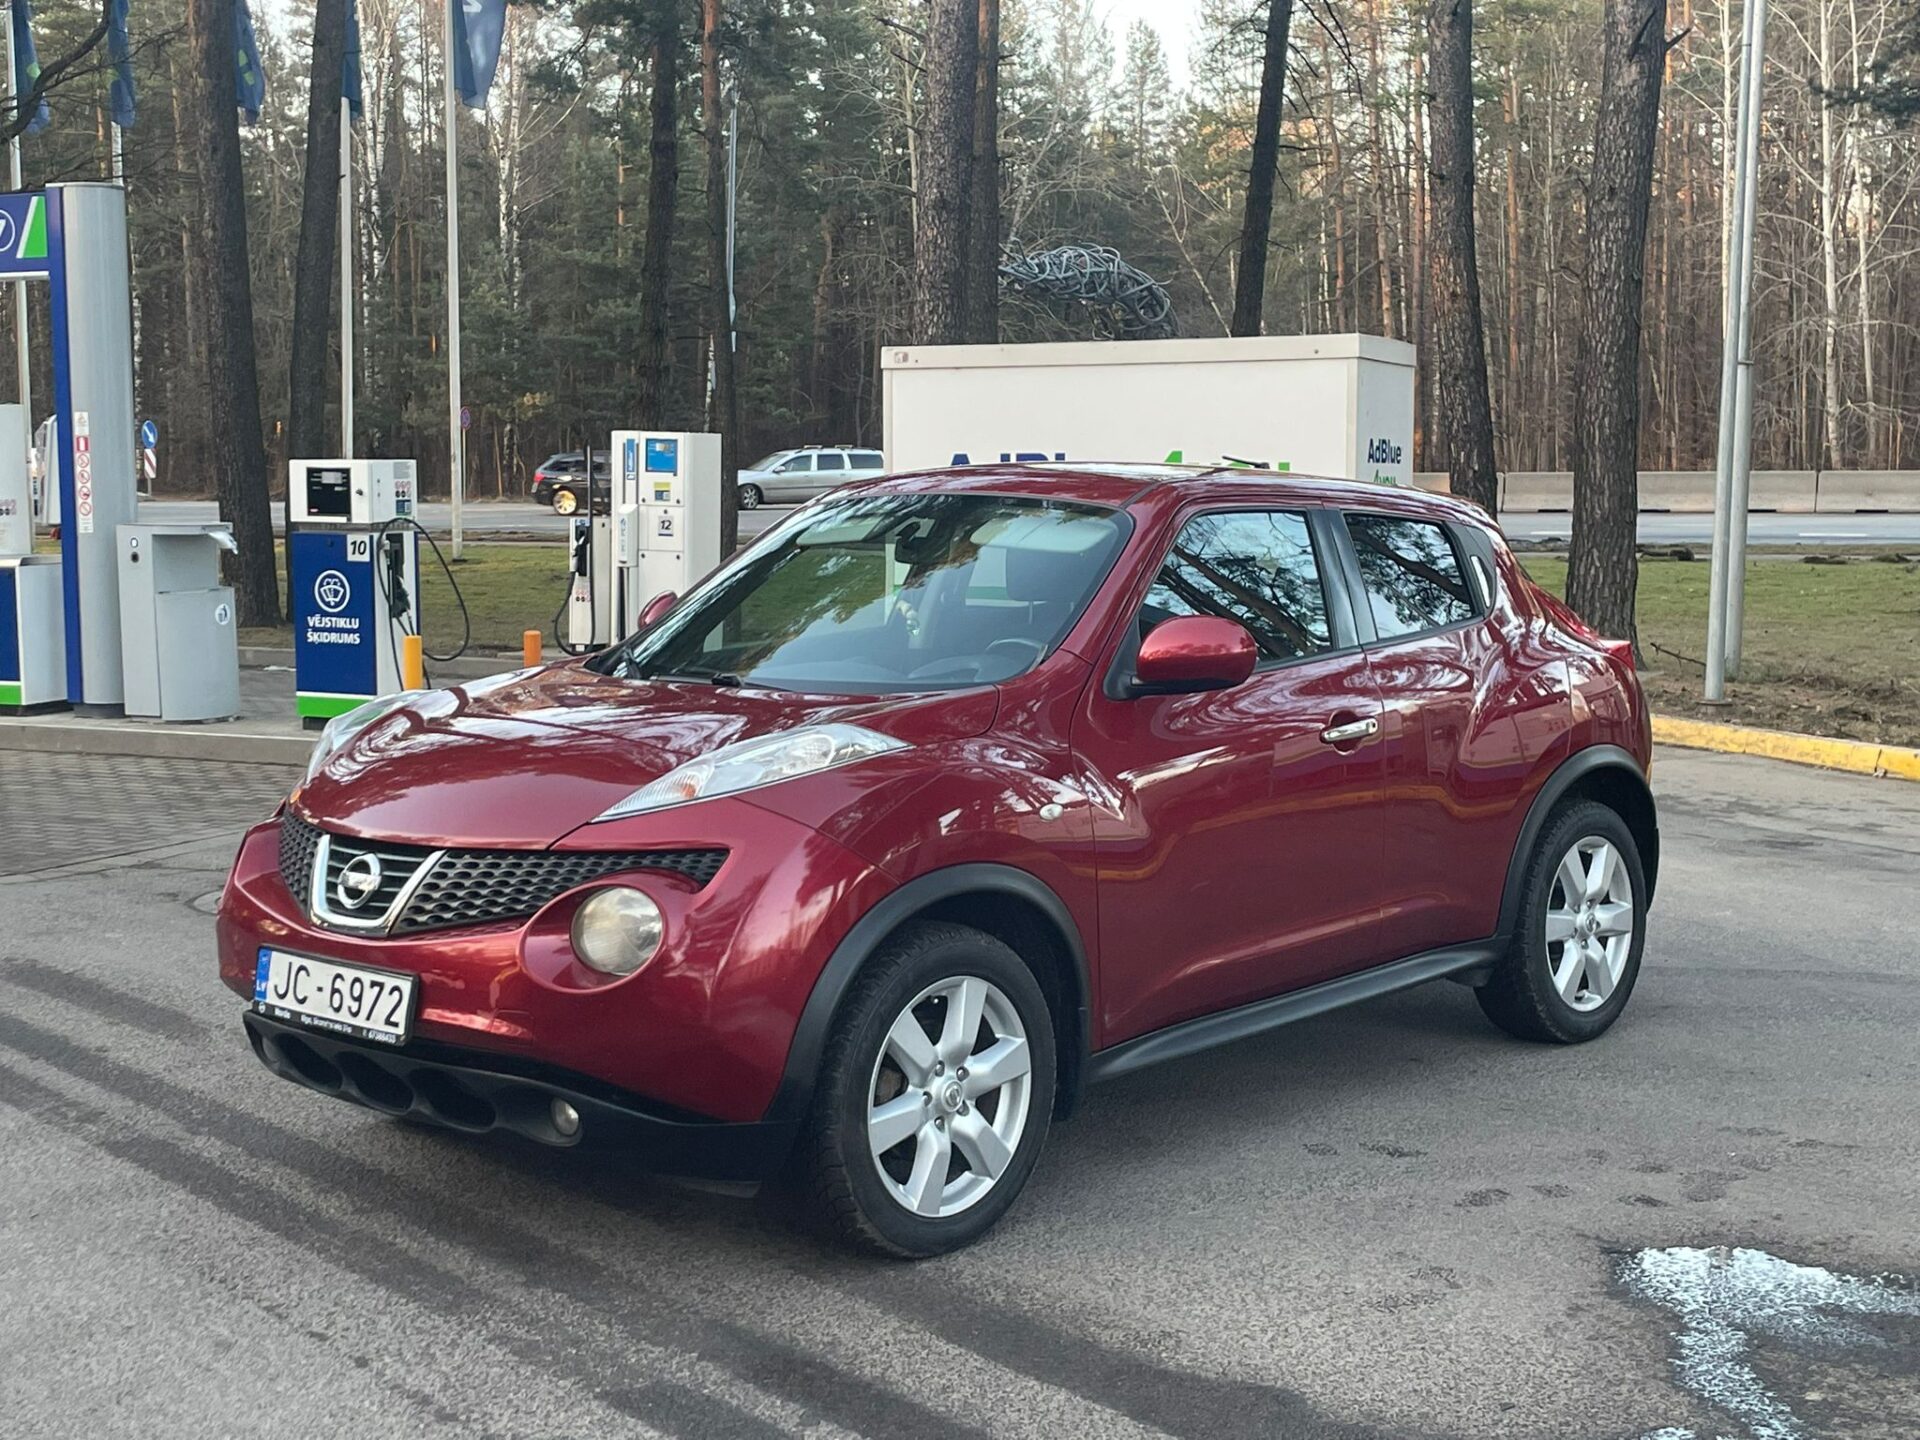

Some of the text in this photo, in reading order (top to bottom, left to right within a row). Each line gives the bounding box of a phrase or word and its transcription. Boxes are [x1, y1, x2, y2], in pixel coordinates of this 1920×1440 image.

[1367, 437, 1401, 464] AdBlue
[660, 519, 672, 530] 12
[350, 540, 367, 556] 10
[306, 614, 360, 629] VĒJSTIKLU
[306, 628, 361, 645] ŠĶIDRUMS
[274, 961, 404, 1028] JC-6972
